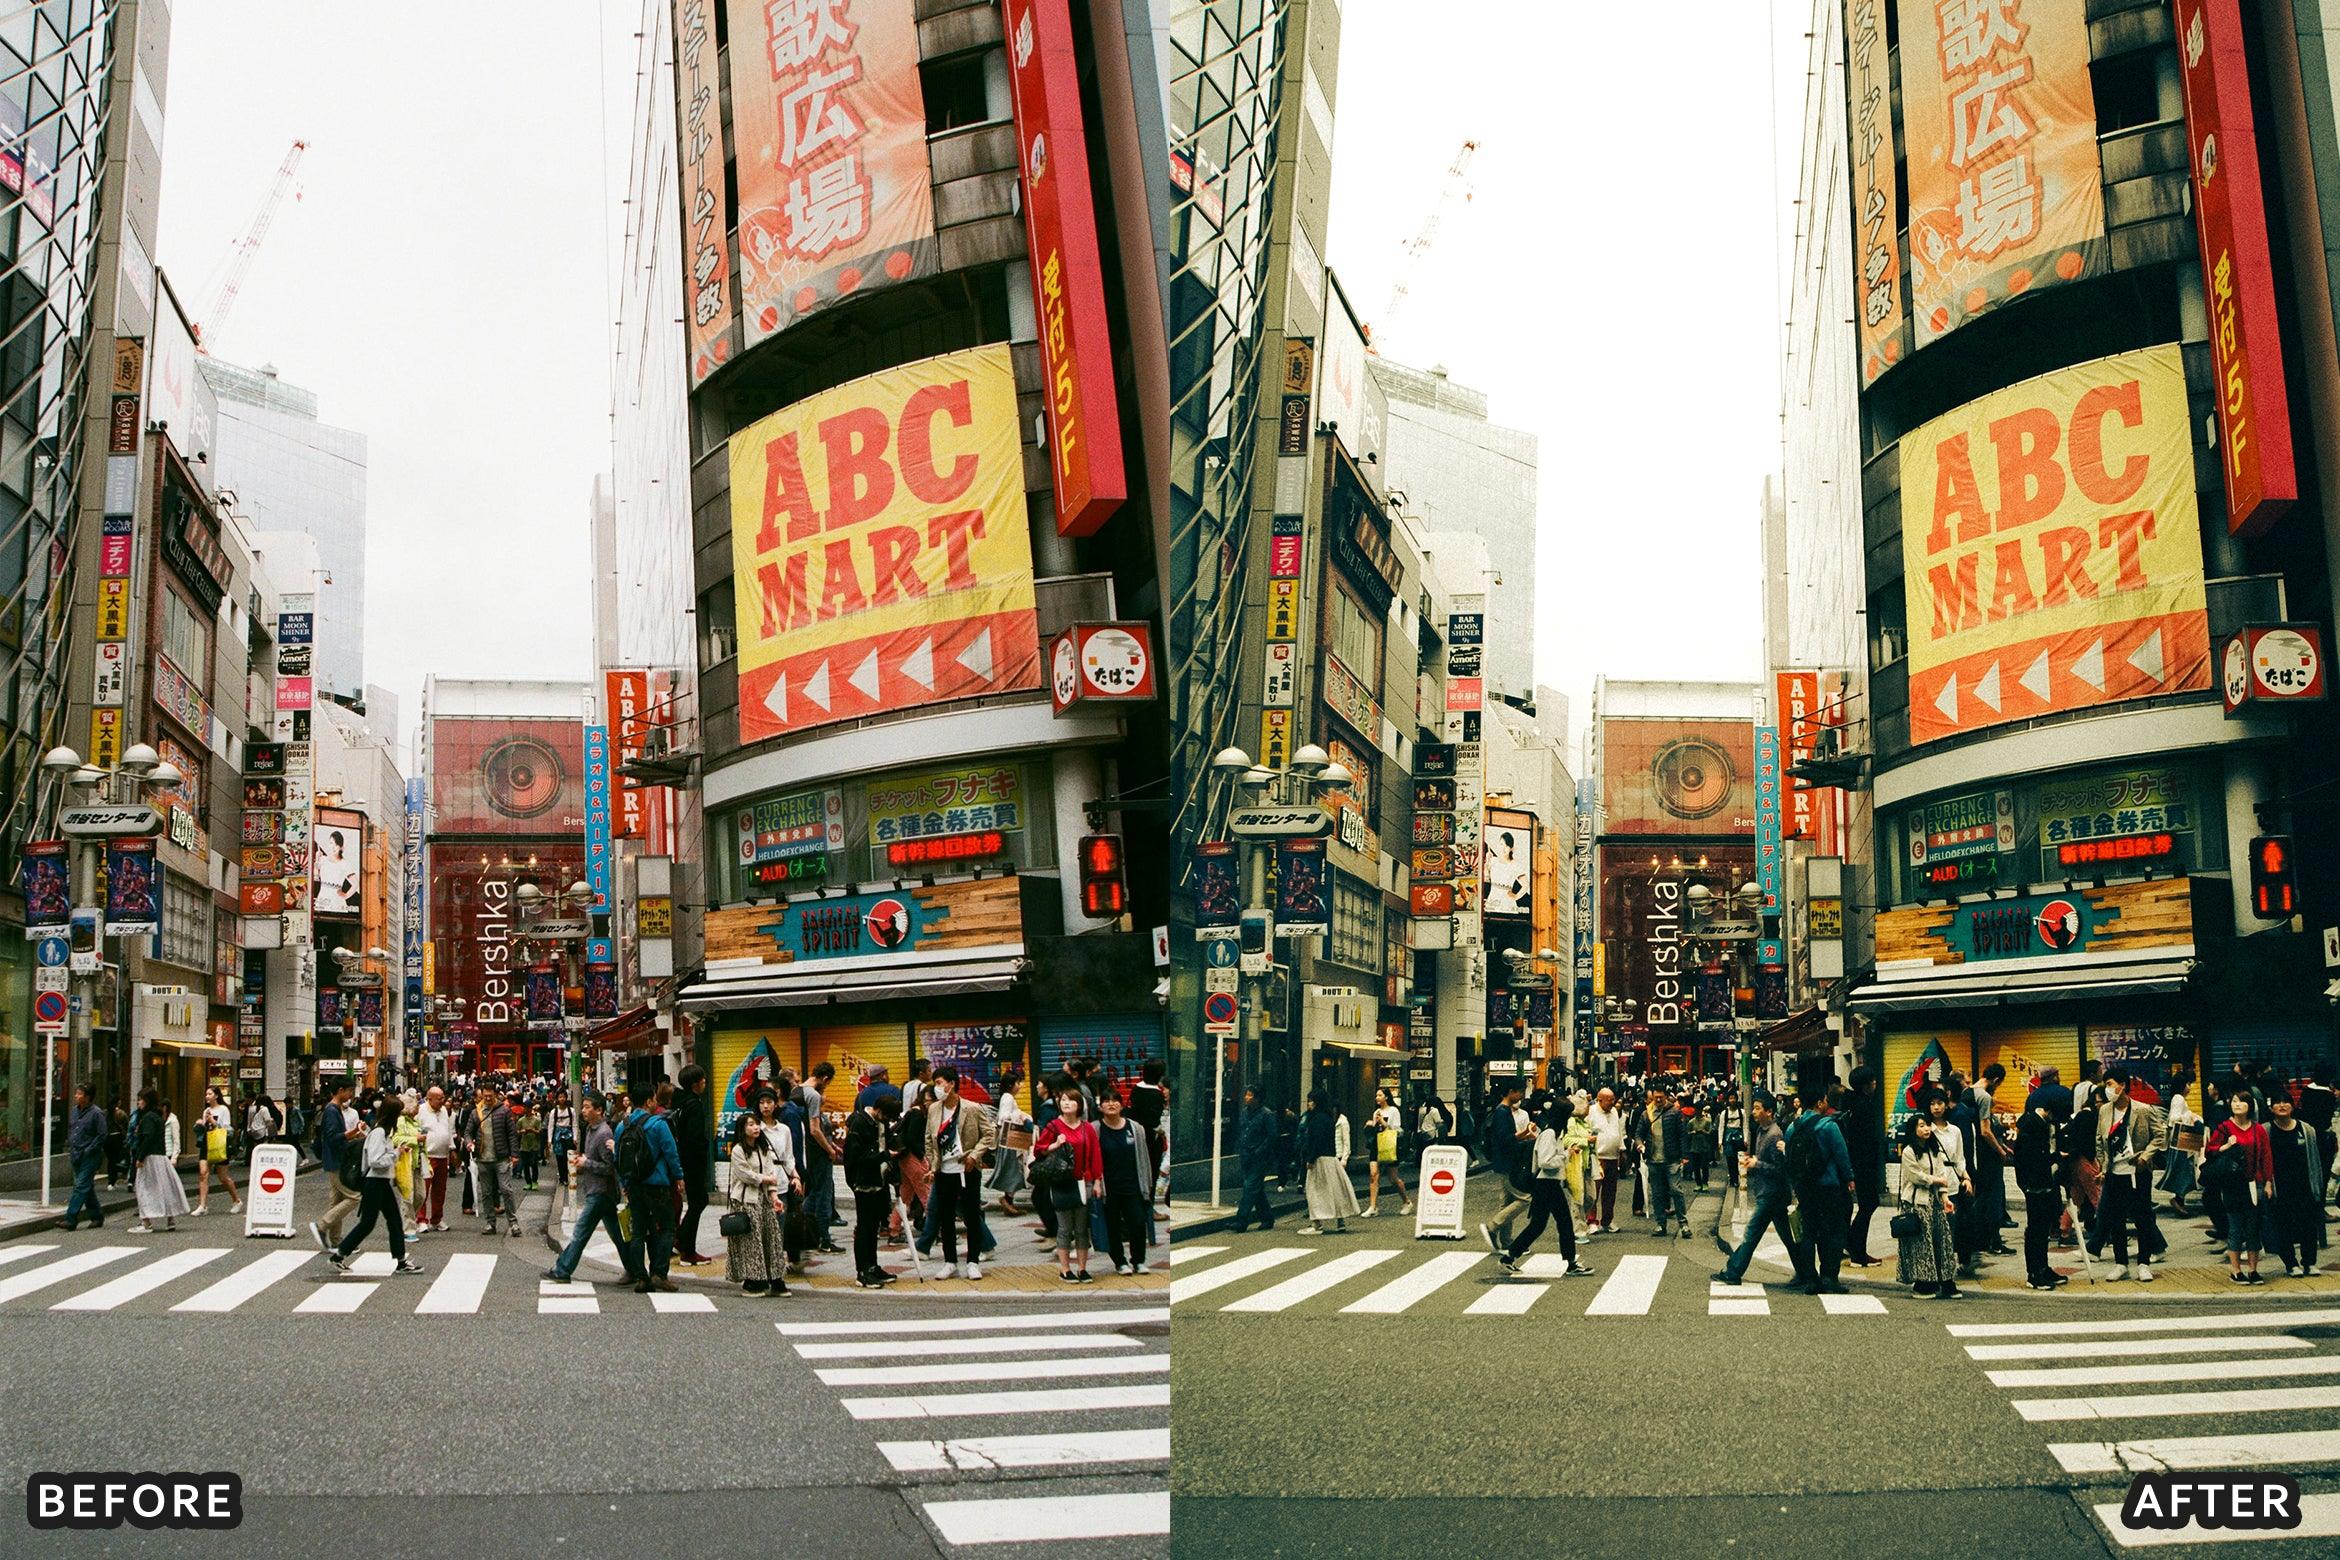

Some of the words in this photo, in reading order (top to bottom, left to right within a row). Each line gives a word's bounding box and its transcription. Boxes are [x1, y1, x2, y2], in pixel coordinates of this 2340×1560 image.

[756, 379, 981, 555] ABC
[1926, 380, 2152, 556] ABC
[757, 508, 987, 640] MART
[1927, 509, 2158, 641] MART
[1094, 667, 1136, 686] たばこ
[2264, 668, 2307, 687] たばこ
[65, 812, 151, 824] 渋谷センター街
[757, 811, 823, 834] EXCHANGE
[476, 880, 509, 1024] Bershka
[1646, 881, 1680, 1025] Bershka
